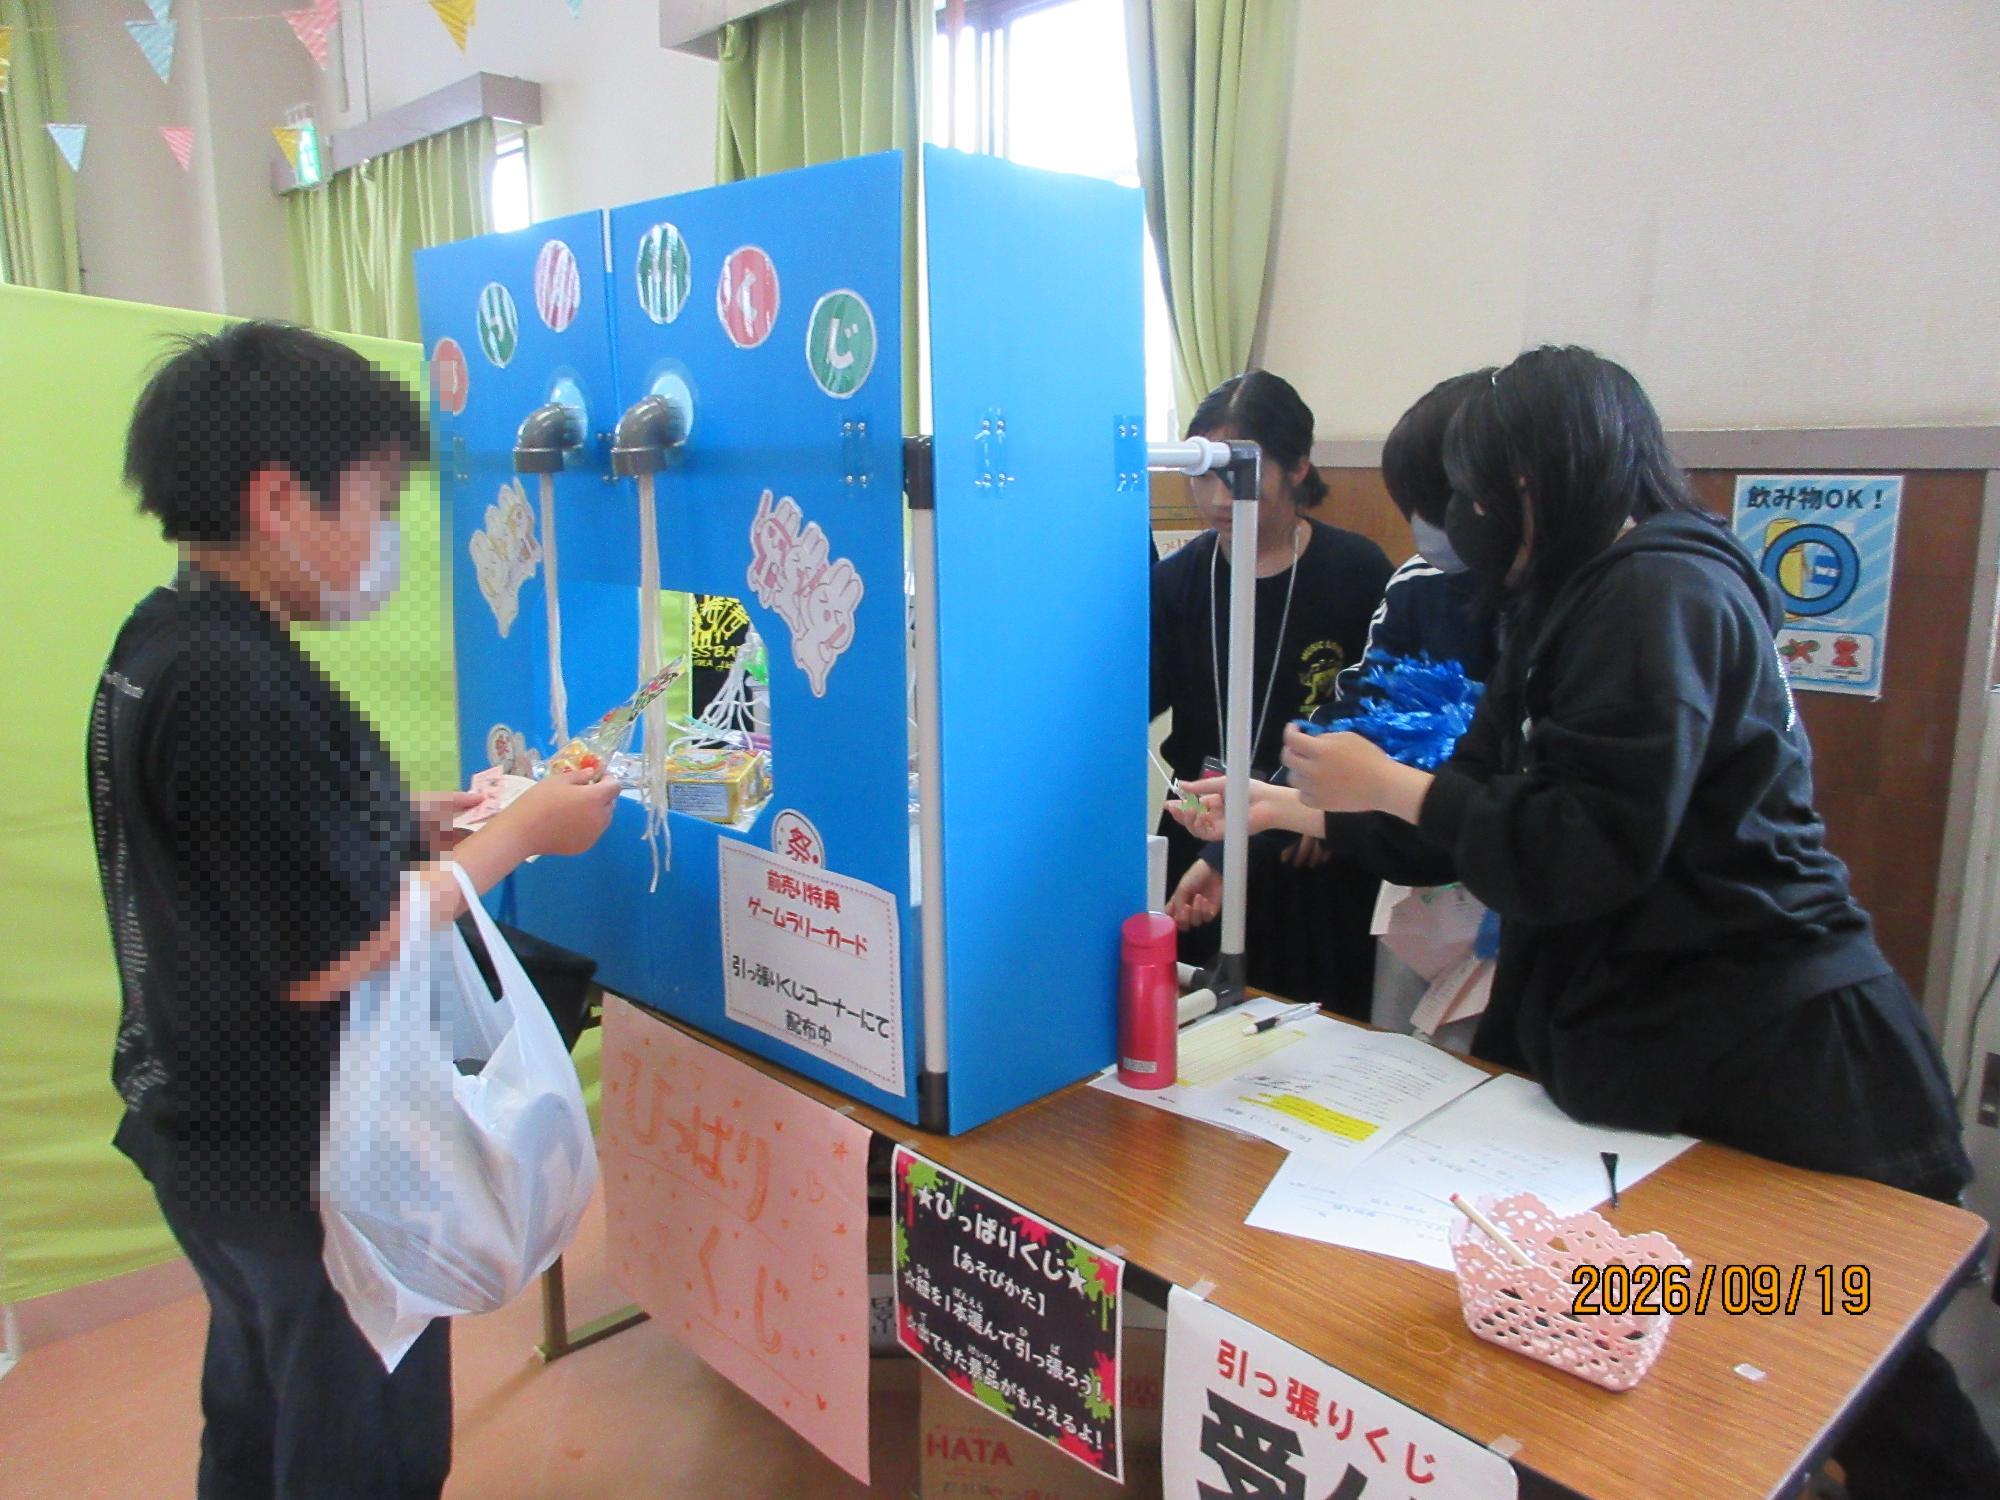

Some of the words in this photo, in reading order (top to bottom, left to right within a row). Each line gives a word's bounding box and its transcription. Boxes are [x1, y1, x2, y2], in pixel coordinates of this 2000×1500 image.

[766, 868, 842, 914] 前売り特典
[748, 895, 868, 957] ゲームラリーカード
[731, 955, 890, 1039] 引っ張りくじコーナーにて
[784, 1008, 833, 1048] 配布中
[1216, 1338, 1439, 1485] 引っ張りくじ
[926, 1432, 1014, 1467] HATA
